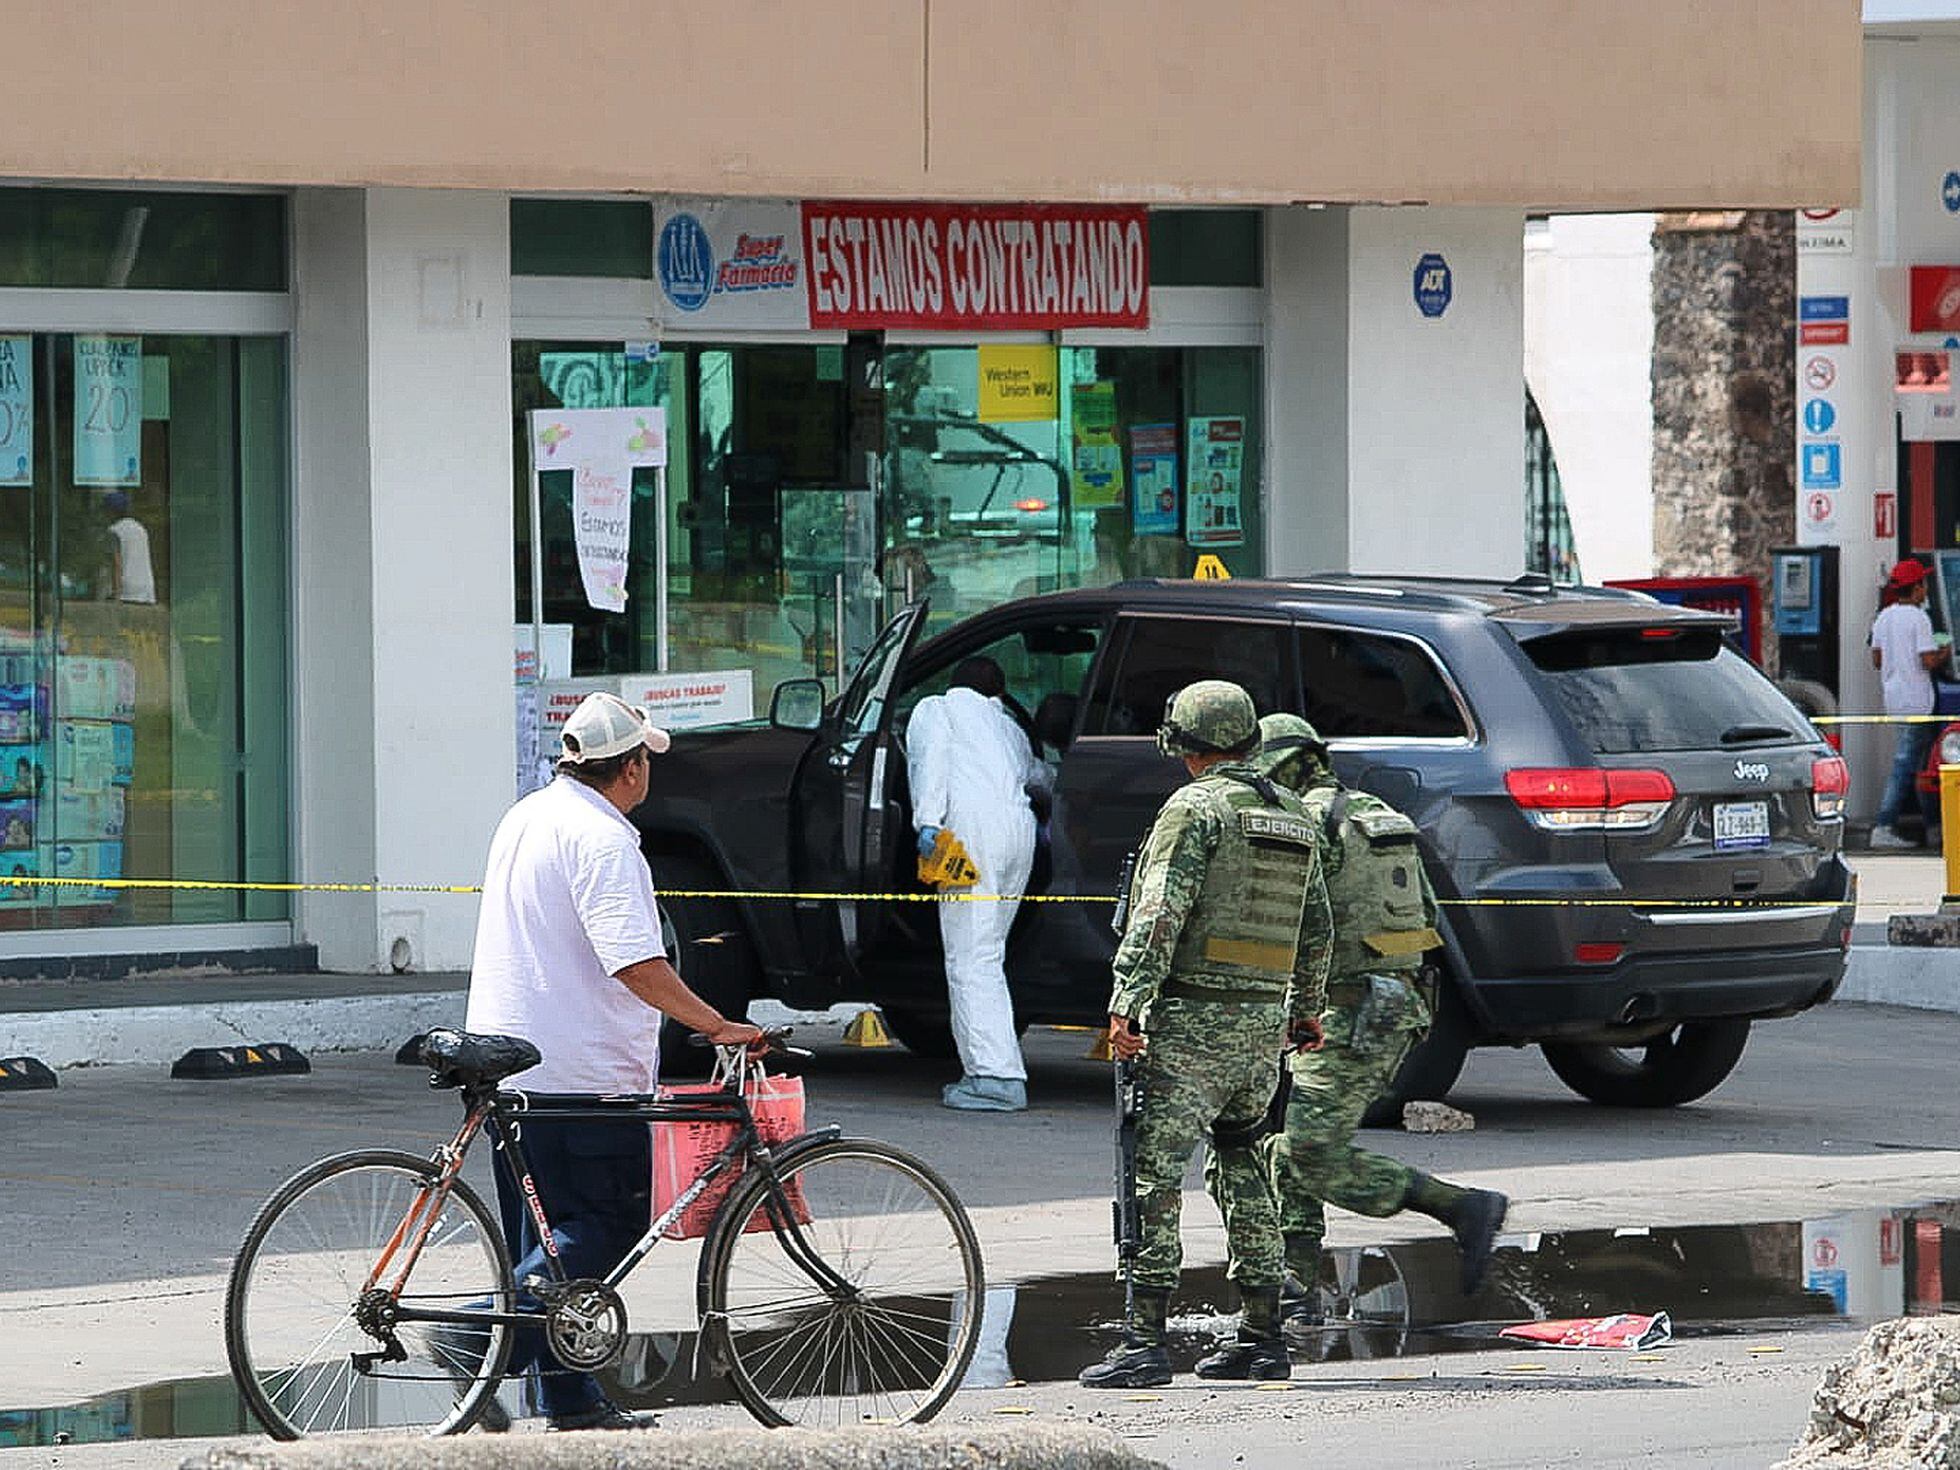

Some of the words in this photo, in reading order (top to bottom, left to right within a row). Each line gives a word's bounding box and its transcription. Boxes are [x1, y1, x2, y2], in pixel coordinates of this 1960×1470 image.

[735, 232, 785, 259] Super
[714, 262, 798, 290] Farmacia
[810, 216, 942, 315] ESTAMOS
[947, 218, 1144, 316] CONTRATANDO
[1420, 269, 1446, 291] ADT
[984, 366, 1029, 381] Western
[1000, 383, 1029, 397] Union
[1733, 760, 1769, 782] Jeep
[1251, 818, 1315, 842] EJERCITO
